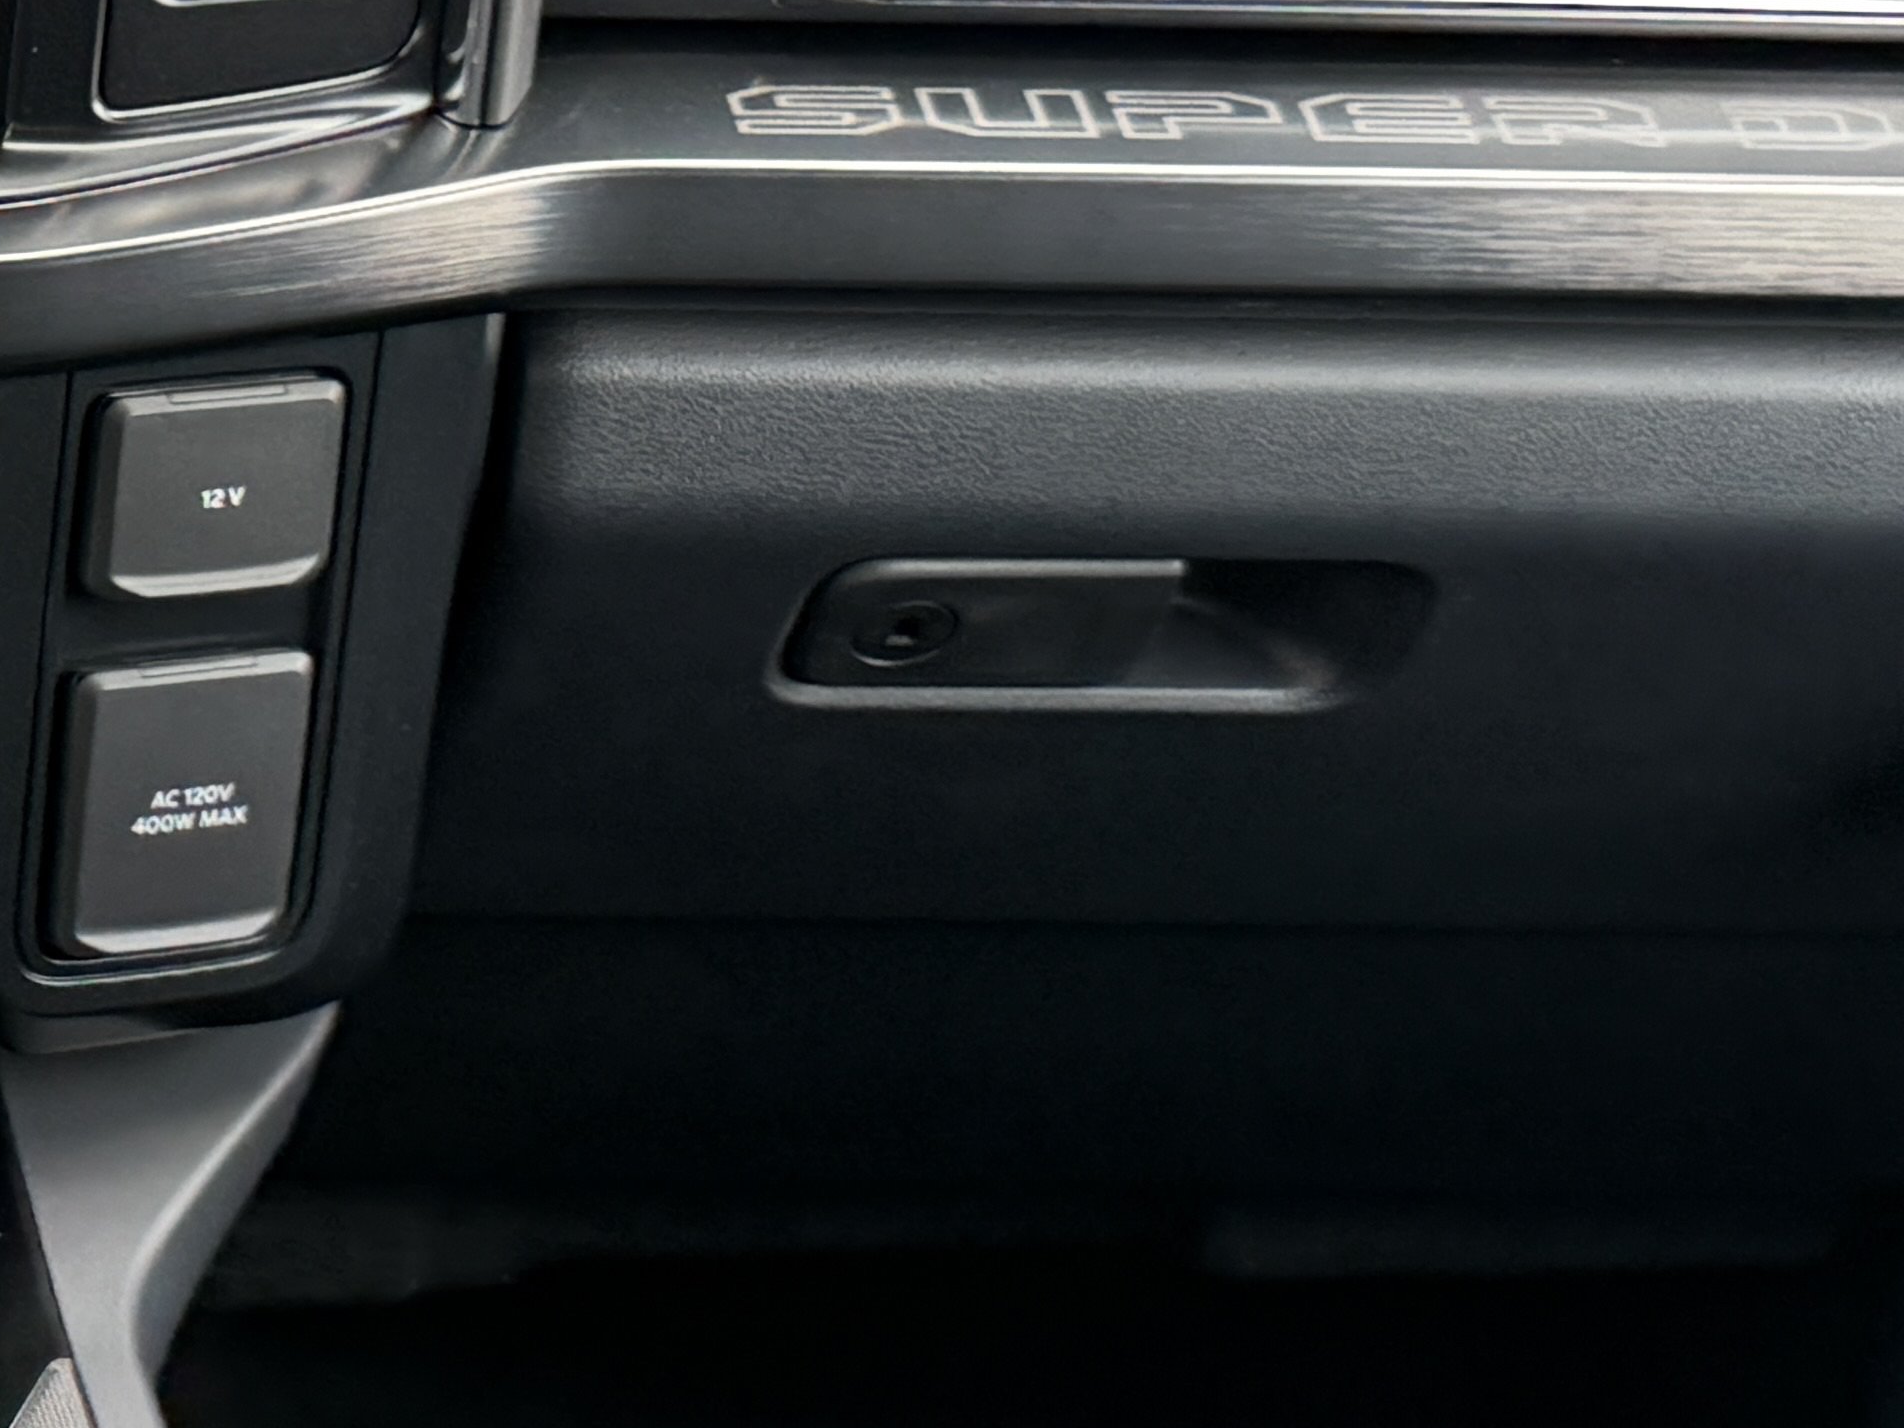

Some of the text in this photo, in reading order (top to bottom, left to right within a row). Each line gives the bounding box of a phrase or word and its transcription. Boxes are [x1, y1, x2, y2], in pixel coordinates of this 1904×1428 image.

[727, 82, 1668, 149] SUPER
[201, 486, 246, 510] 12 V
[151, 782, 235, 809] AC 120V
[130, 805, 248, 835] 400W MAX
